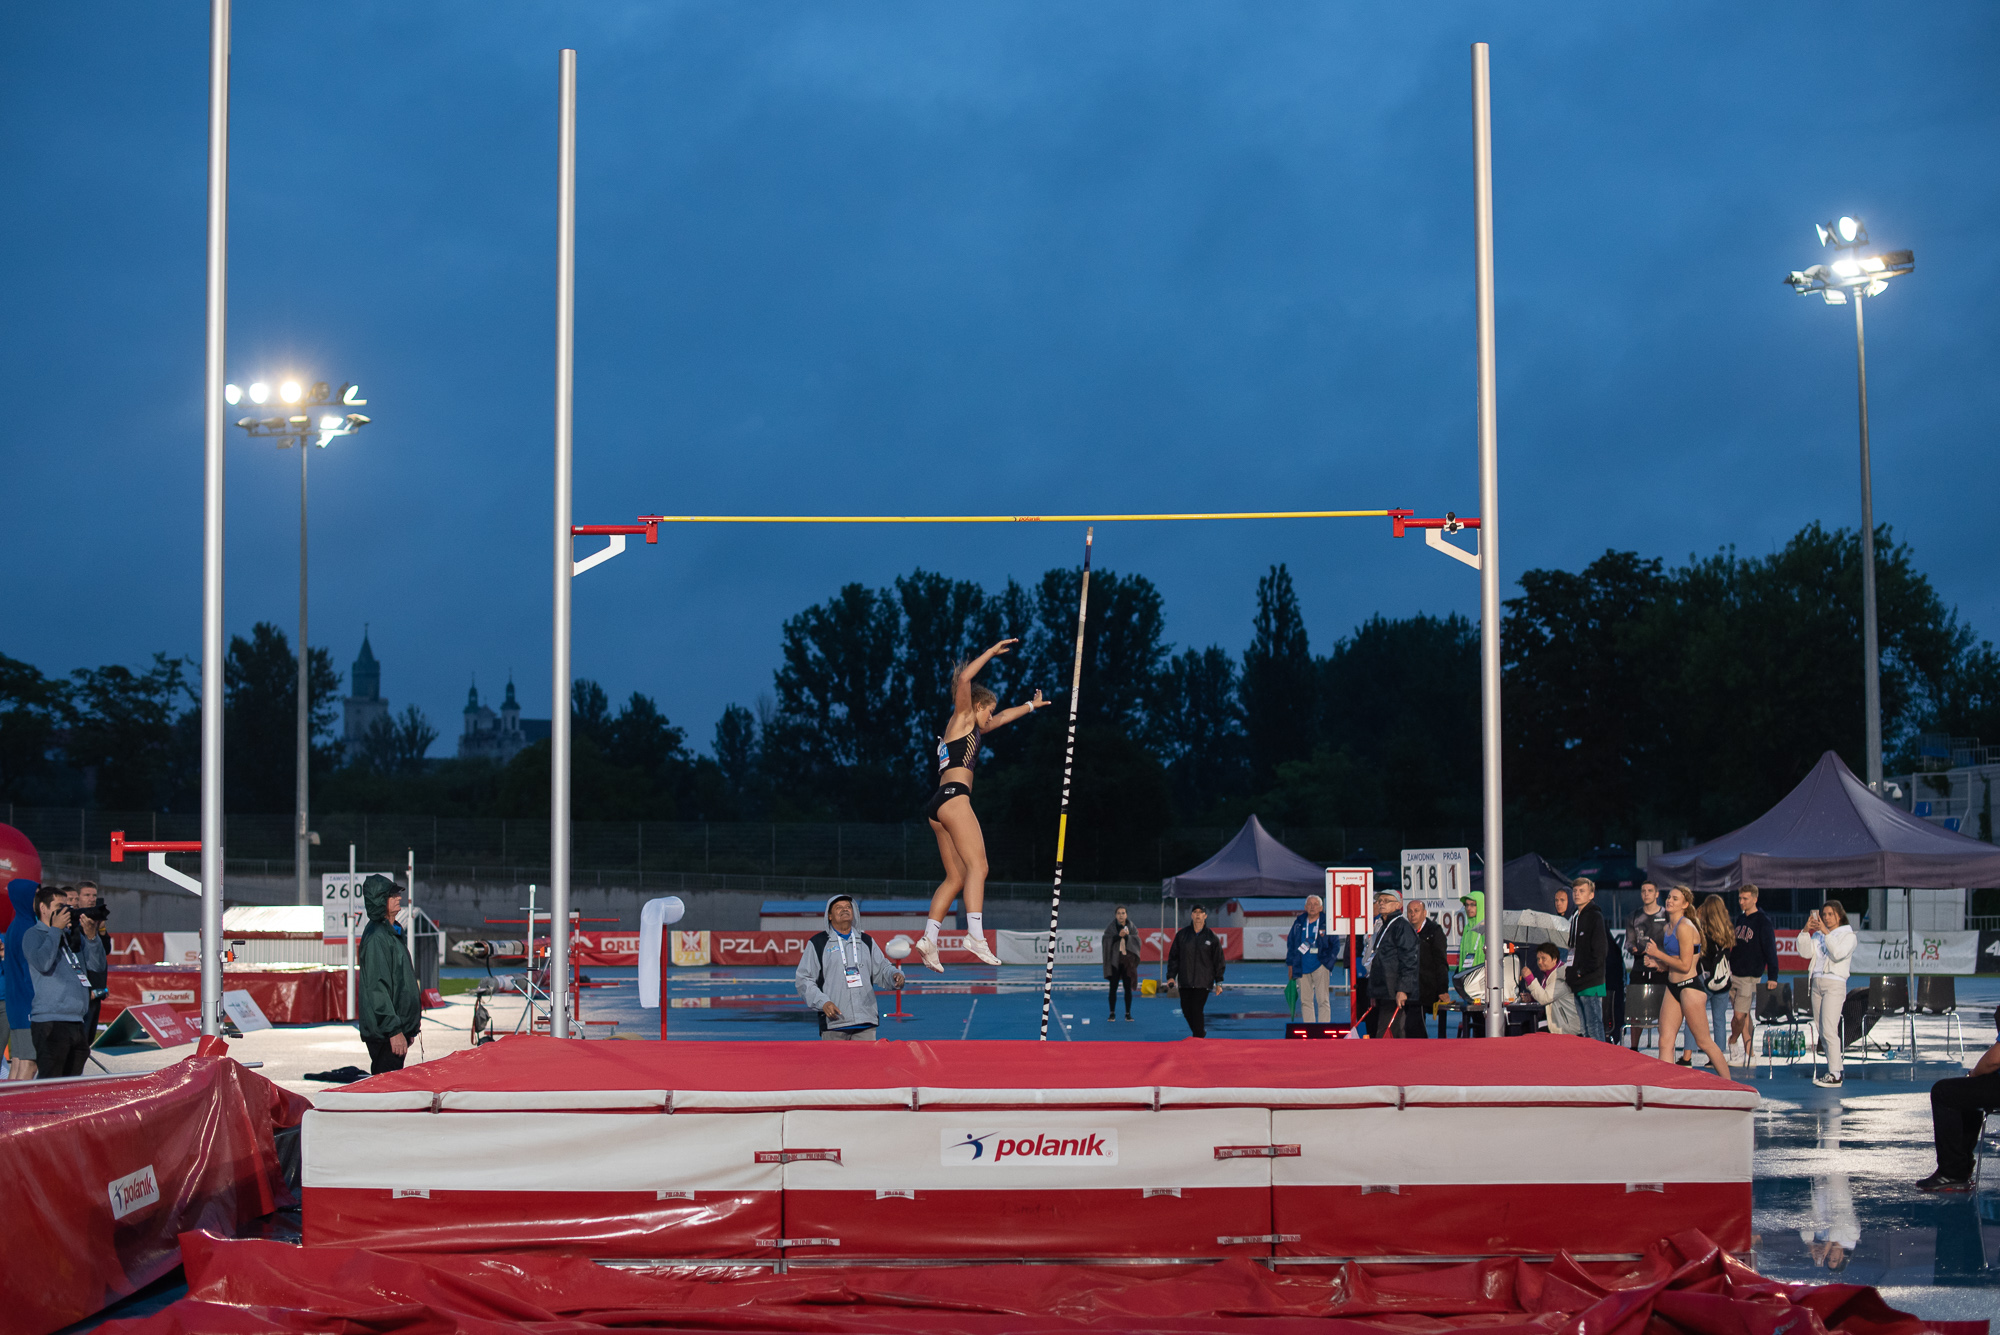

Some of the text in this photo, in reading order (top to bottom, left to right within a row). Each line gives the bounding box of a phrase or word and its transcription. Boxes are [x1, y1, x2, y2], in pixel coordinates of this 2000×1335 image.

[1407, 851, 1462, 861] ZAWODNIK PRÓBA
[1403, 865, 1456, 890] 518 1
[326, 884, 363, 899] 260
[604, 940, 640, 952] ORLE
[937, 938, 964, 949] RLEN
[157, 992, 190, 1001] polanik
[993, 1133, 1106, 1162] polanik
[123, 1172, 154, 1210] polanik
